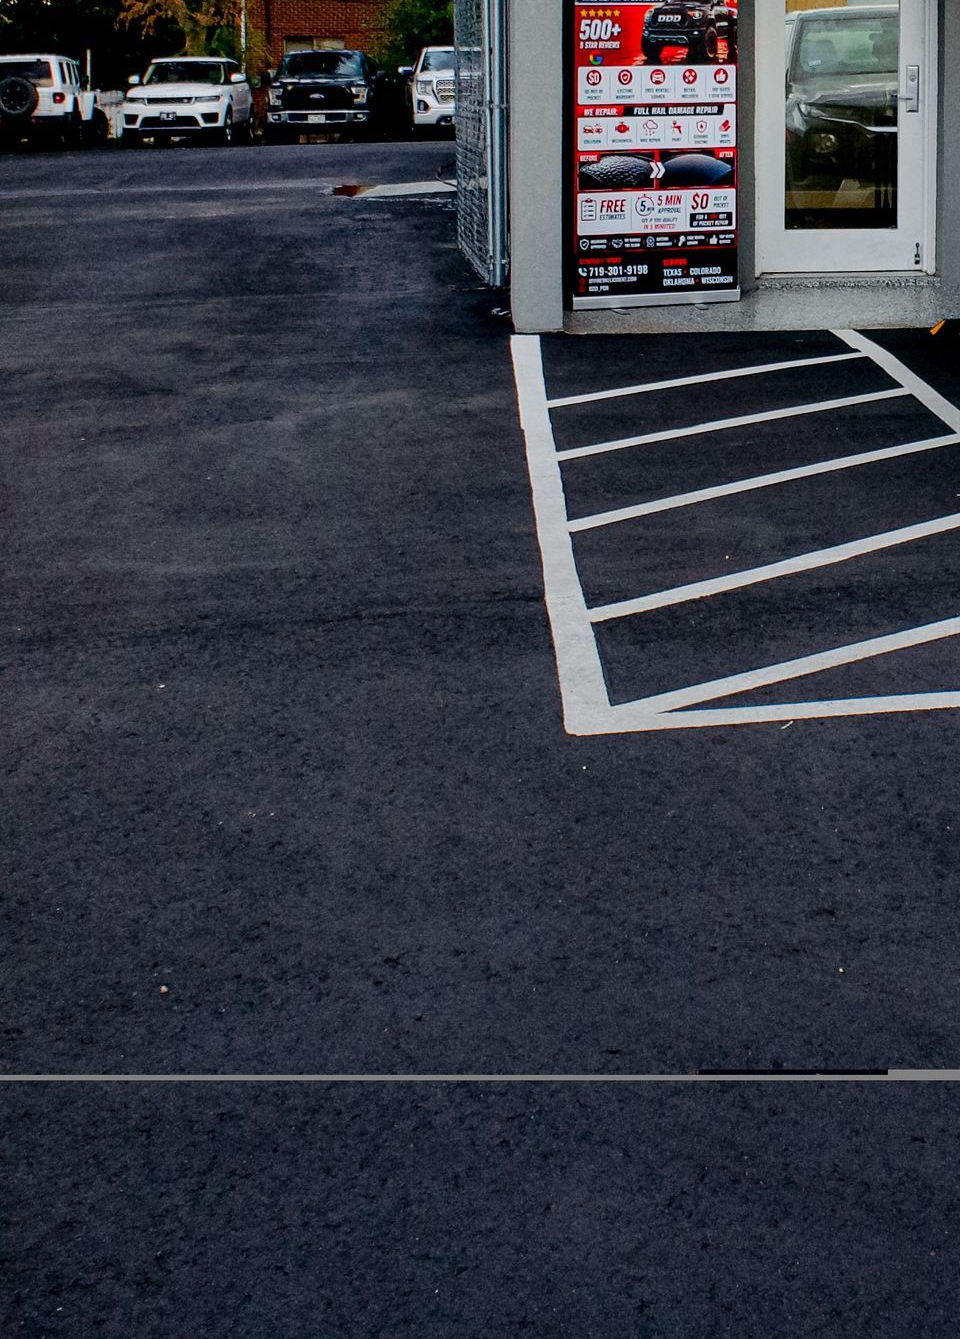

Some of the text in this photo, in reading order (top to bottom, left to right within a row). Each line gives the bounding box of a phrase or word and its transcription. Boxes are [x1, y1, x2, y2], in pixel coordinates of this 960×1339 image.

[657, 14, 682, 22] DDD
[579, 19, 621, 40] 500+
[583, 108, 594, 116] WE
[633, 106, 719, 115] FULL HAIL DAMAGE REPAIR
[600, 199, 626, 213] FREE
[640, 200, 646, 212] 5
[657, 194, 682, 206] 5 MIN
[691, 192, 709, 211] $0
[588, 264, 649, 277] 719-301-9198
[663, 266, 722, 276] TEXAS COLORADO
[663, 276, 734, 286] OKLAHOMA WISCONSIN
